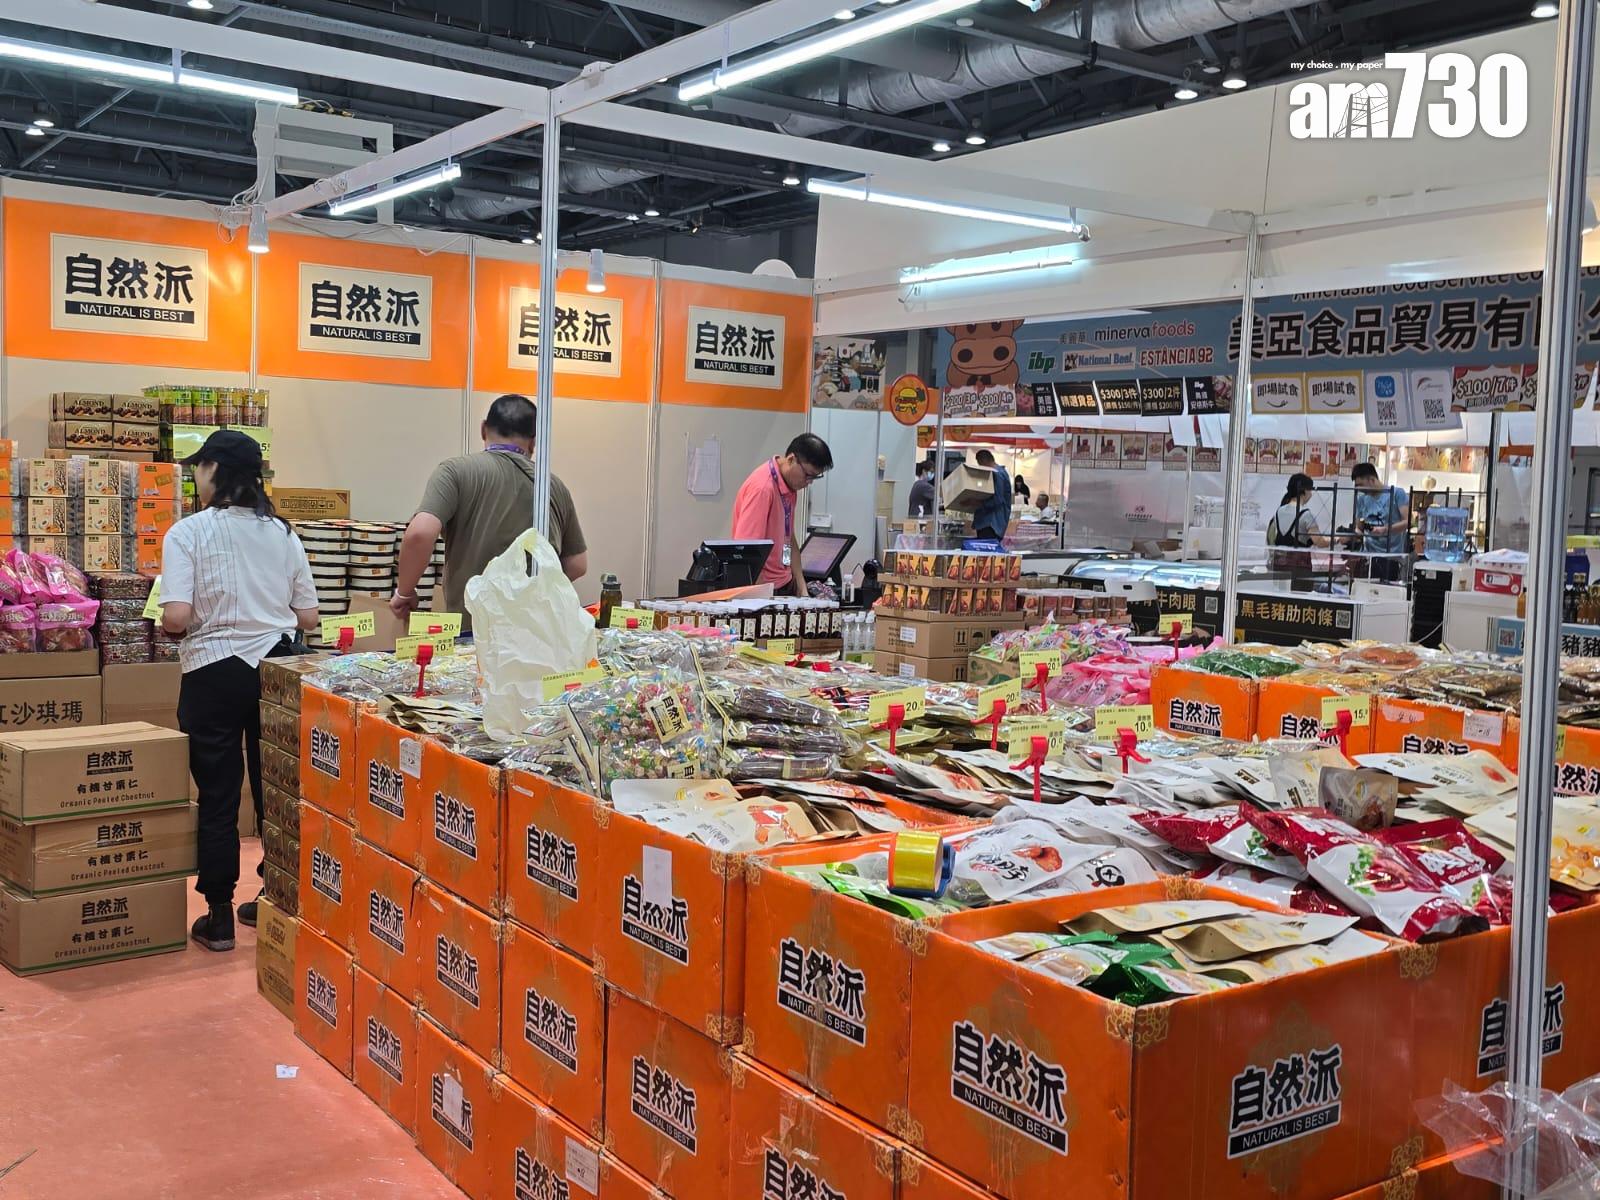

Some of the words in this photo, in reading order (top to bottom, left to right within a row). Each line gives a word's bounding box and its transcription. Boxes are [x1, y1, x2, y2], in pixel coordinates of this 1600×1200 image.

[65, 252, 194, 304] 自然派
[80, 304, 136, 319] NATURAL
[139, 308, 150, 319] IS
[154, 309, 185, 322] BEST
[311, 280, 420, 327] 自然派
[322, 327, 370, 340] NATURAL
[373, 330, 382, 340] IS
[385, 331, 412, 343] BEST
[696, 321, 775, 361] 自然派
[1229, 297, 1600, 359] 美亞食品貿易有
[529, 346, 569, 358] NARAL
[572, 349, 579, 358] IS
[582, 350, 604, 360] BEST
[703, 361, 739, 372] NATURAL
[741, 364, 747, 372] IS
[749, 364, 769, 375] BEST
[1028, 352, 1055, 373] ibp
[1257, 382, 1298, 397] 即場試食
[1313, 382, 1355, 396] 即場試食
[1456, 376, 1518, 399] $100/7件
[1242, 600, 1335, 626] 黑毛豬肋肉條
[663, 696, 685, 732] 自然派
[1170, 700, 1222, 726] 自然派
[87, 750, 133, 768] 自然派
[312, 728, 339, 764] 自然派
[370, 761, 403, 804] 自然派
[97, 821, 143, 840] 自然派
[436, 793, 475, 841] 自然派
[313, 848, 341, 889] 自然派
[528, 826, 577, 882] 自然派
[82, 897, 127, 918] 自然派
[370, 891, 404, 941] 自然派
[629, 926, 656, 946] NATURAL
[658, 939, 664, 948] IS
[665, 942, 681, 958] BEST
[438, 935, 478, 990] 自然派
[780, 940, 863, 1019] 自然派
[308, 969, 336, 1012] 自然派
[527, 989, 576, 1053] 自然派
[1481, 984, 1563, 1052] 自派
[369, 1018, 402, 1068] 自然派
[954, 1023, 1065, 1122] 自然派
[1232, 1046, 1341, 1129] 自然派
[433, 1075, 472, 1136] 自派
[634, 1057, 695, 1130] 自然派
[639, 1106, 665, 1130] NATURAL
[666, 1122, 672, 1134] IS
[673, 1126, 690, 1144] BEST
[965, 1089, 1011, 1119] NATURAL
[1013, 1112, 1024, 1128] IS
[1026, 1118, 1056, 1143] BEST
[1243, 1127, 1290, 1149] NATURAL
[1293, 1121, 1302, 1132] IS
[1305, 1111, 1330, 1130] BEST
